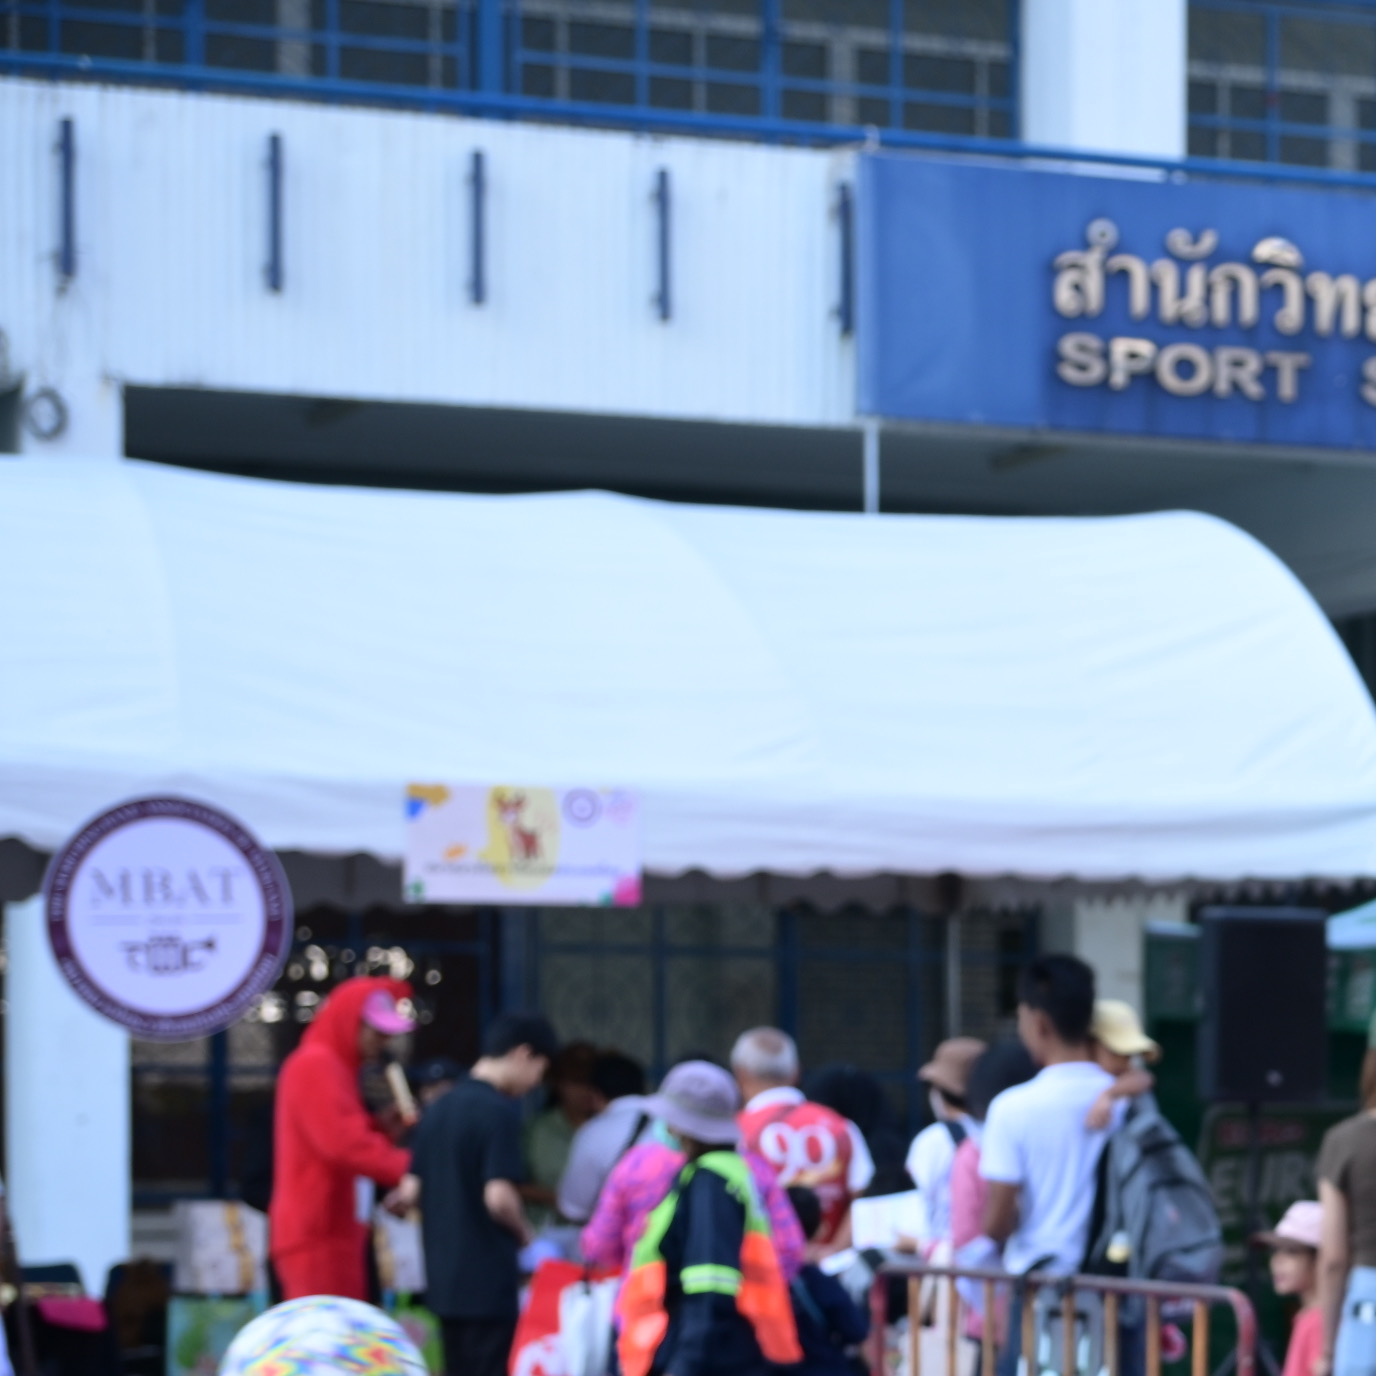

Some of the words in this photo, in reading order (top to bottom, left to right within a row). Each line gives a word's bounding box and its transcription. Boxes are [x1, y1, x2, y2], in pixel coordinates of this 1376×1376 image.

[1056, 331, 1311, 402] SPORT
[91, 865, 246, 907] MBAT
[758, 1120, 838, 1188] 90
